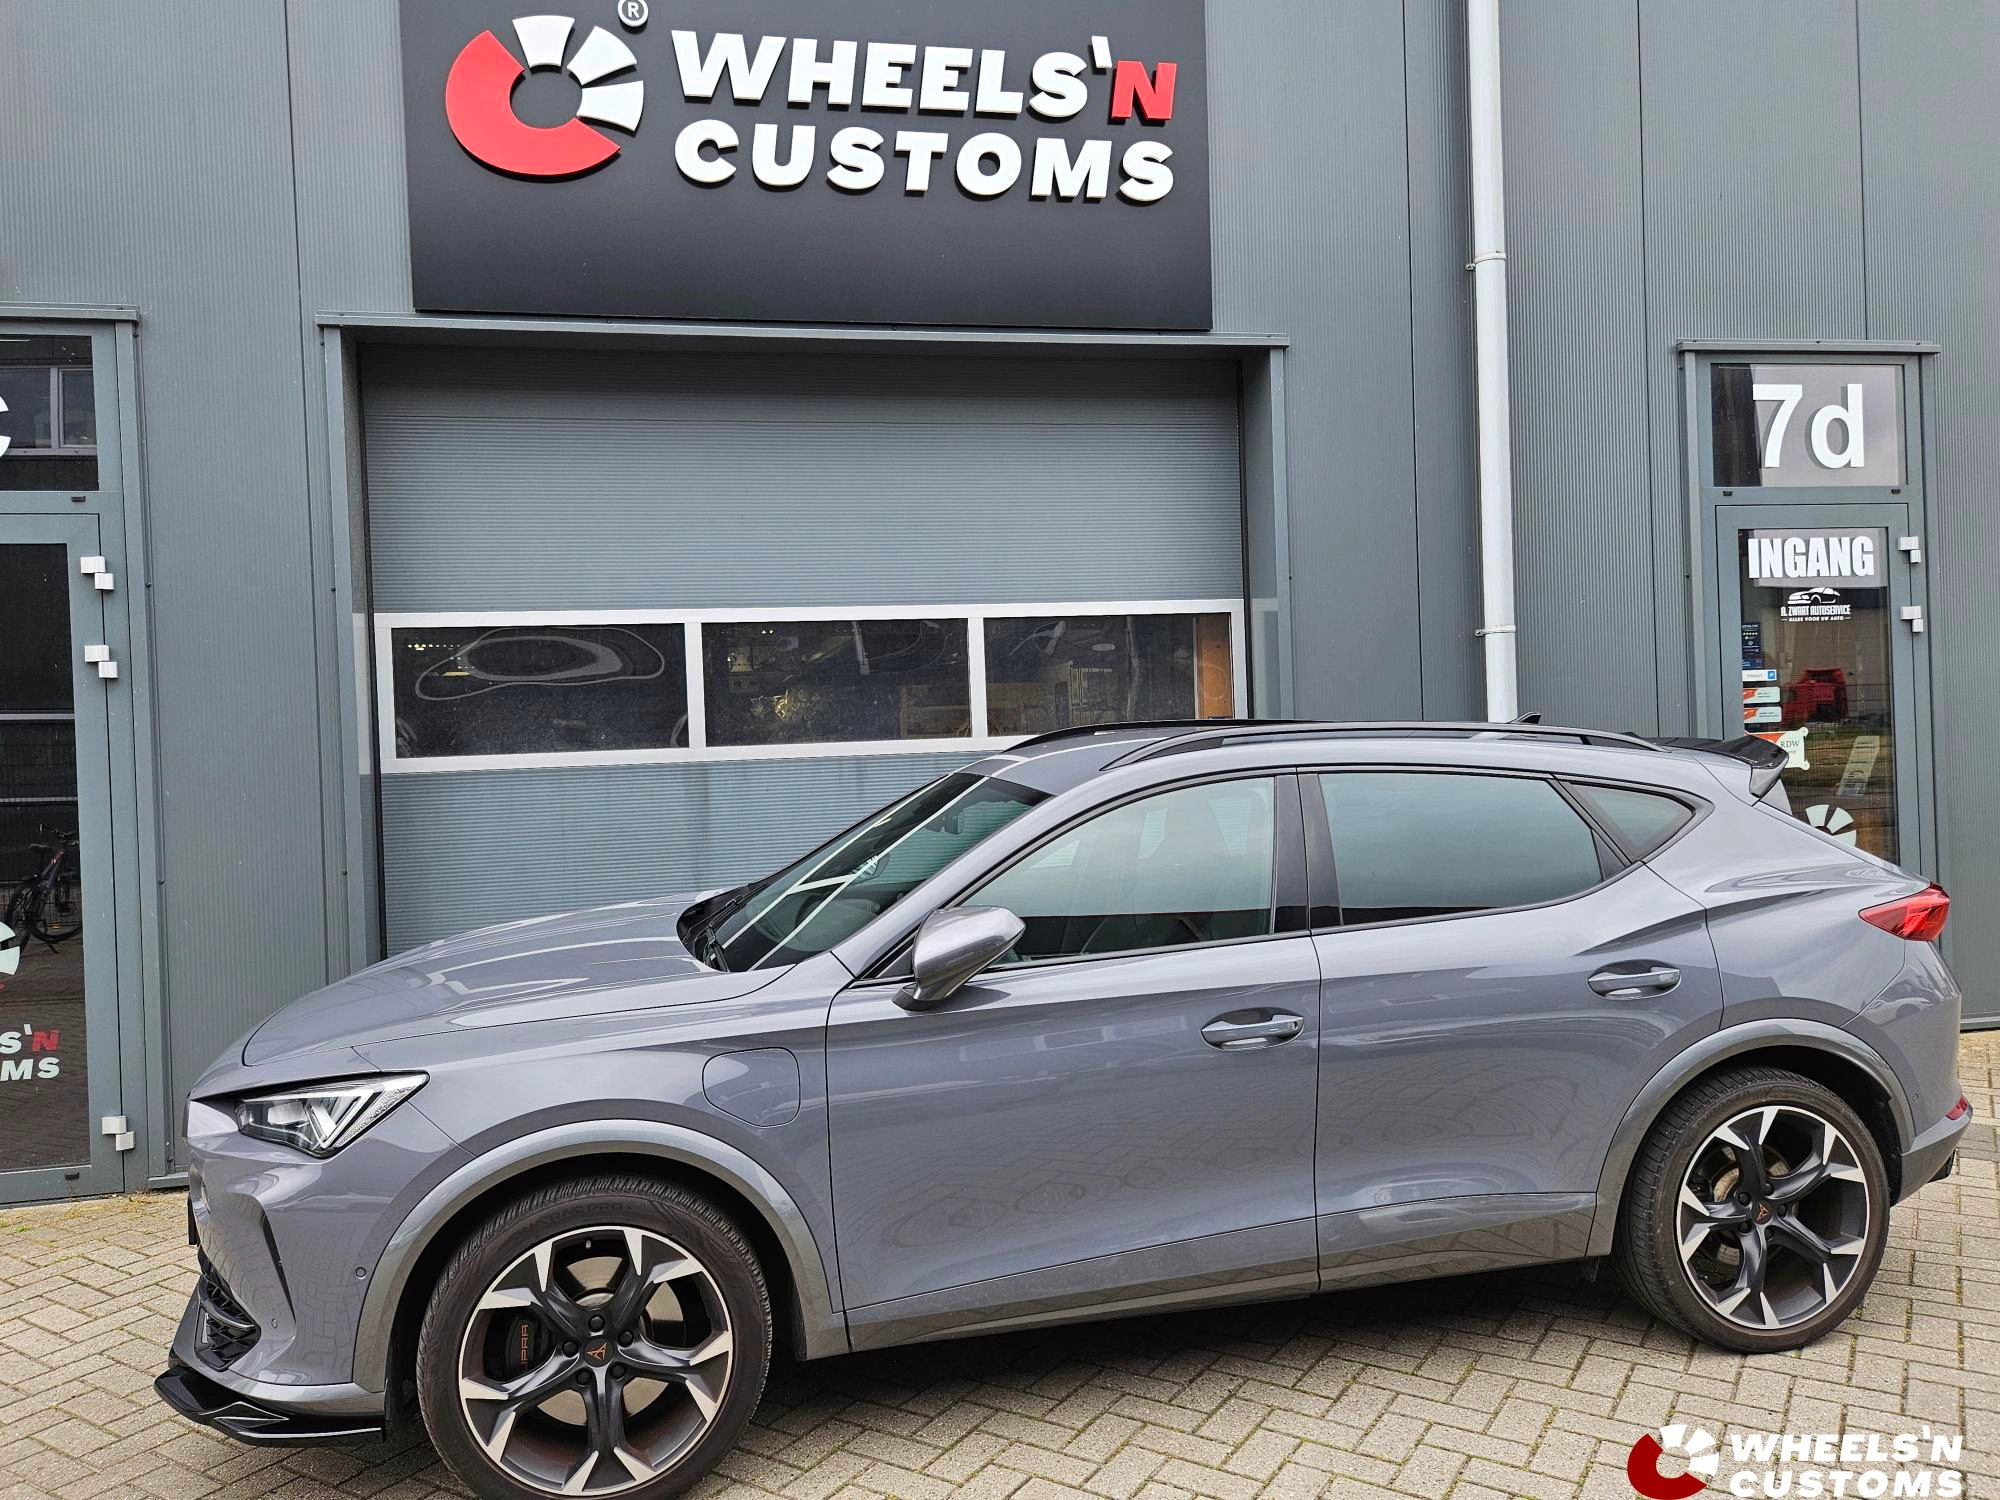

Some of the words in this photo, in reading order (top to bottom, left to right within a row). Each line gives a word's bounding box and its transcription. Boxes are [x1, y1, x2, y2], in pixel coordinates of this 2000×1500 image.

[670, 30, 1177, 121] WHEELS'N
[673, 119, 1175, 202] CUSTOMS
[1752, 383, 1865, 469] 7d
[1748, 536, 1875, 579] INGANG
[1788, 605, 1810, 616] ZWART
[1810, 604, 1851, 616] AUTOSERVICE
